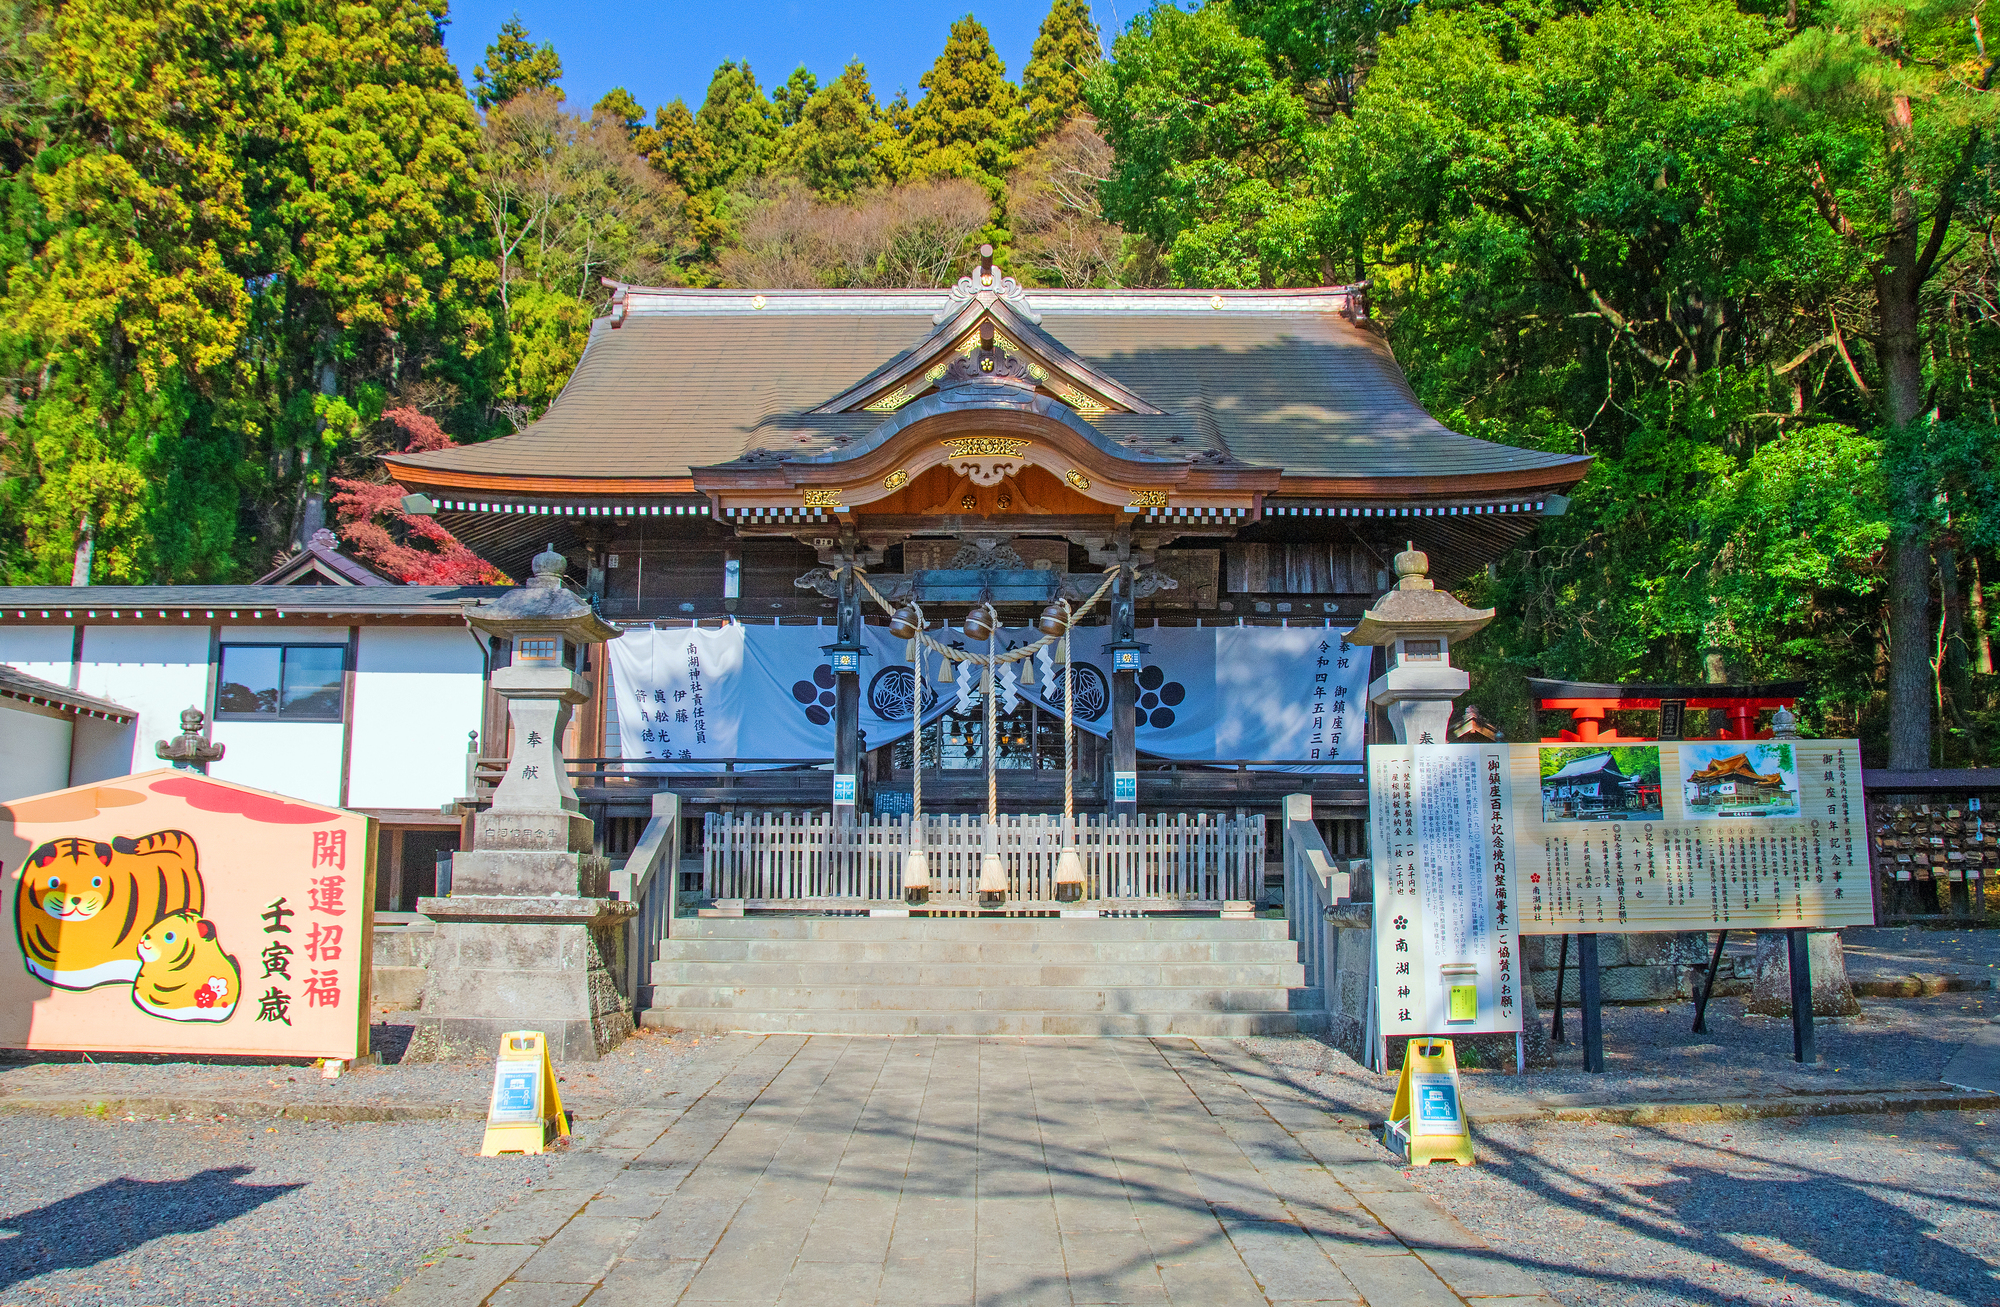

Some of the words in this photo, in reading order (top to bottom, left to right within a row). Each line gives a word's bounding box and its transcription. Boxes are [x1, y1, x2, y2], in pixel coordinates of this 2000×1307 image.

[1336, 641, 1351, 669] 奉祝
[673, 690, 689, 723] 伊藤
[686, 643, 707, 744] 南湖神社責任役員
[1310, 640, 1331, 760] 令和四年五月三日
[1328, 685, 1347, 760] 御鎮座百年
[521, 730, 543, 780] 奉献
[1391, 759, 1402, 836] 一、屋根銅板奉納金
[1402, 759, 1414, 836] 一、整備事業協賛金
[1394, 843, 1403, 858] 一枚
[1406, 843, 1414, 857] 一口
[1822, 753, 1844, 900] 御鎮座百年記念事業
[1844, 828, 1854, 867] 第四期事業
[1395, 864, 1404, 896] 二千円也
[1407, 863, 1416, 896] 五千円也
[1486, 754, 1513, 1018] 「御鎮座百年記念境内整備事業」ご協賛のお願い
[1631, 836, 1645, 899] 八千万円也
[302, 829, 347, 1008] 開運招福
[1532, 885, 1543, 922] 南湖神社
[1577, 896, 1586, 924] 二千円也
[1596, 895, 1604, 923] 五千円也
[255, 897, 295, 1026] 壬寅歳
[1395, 937, 1412, 1022] 南湖神社
